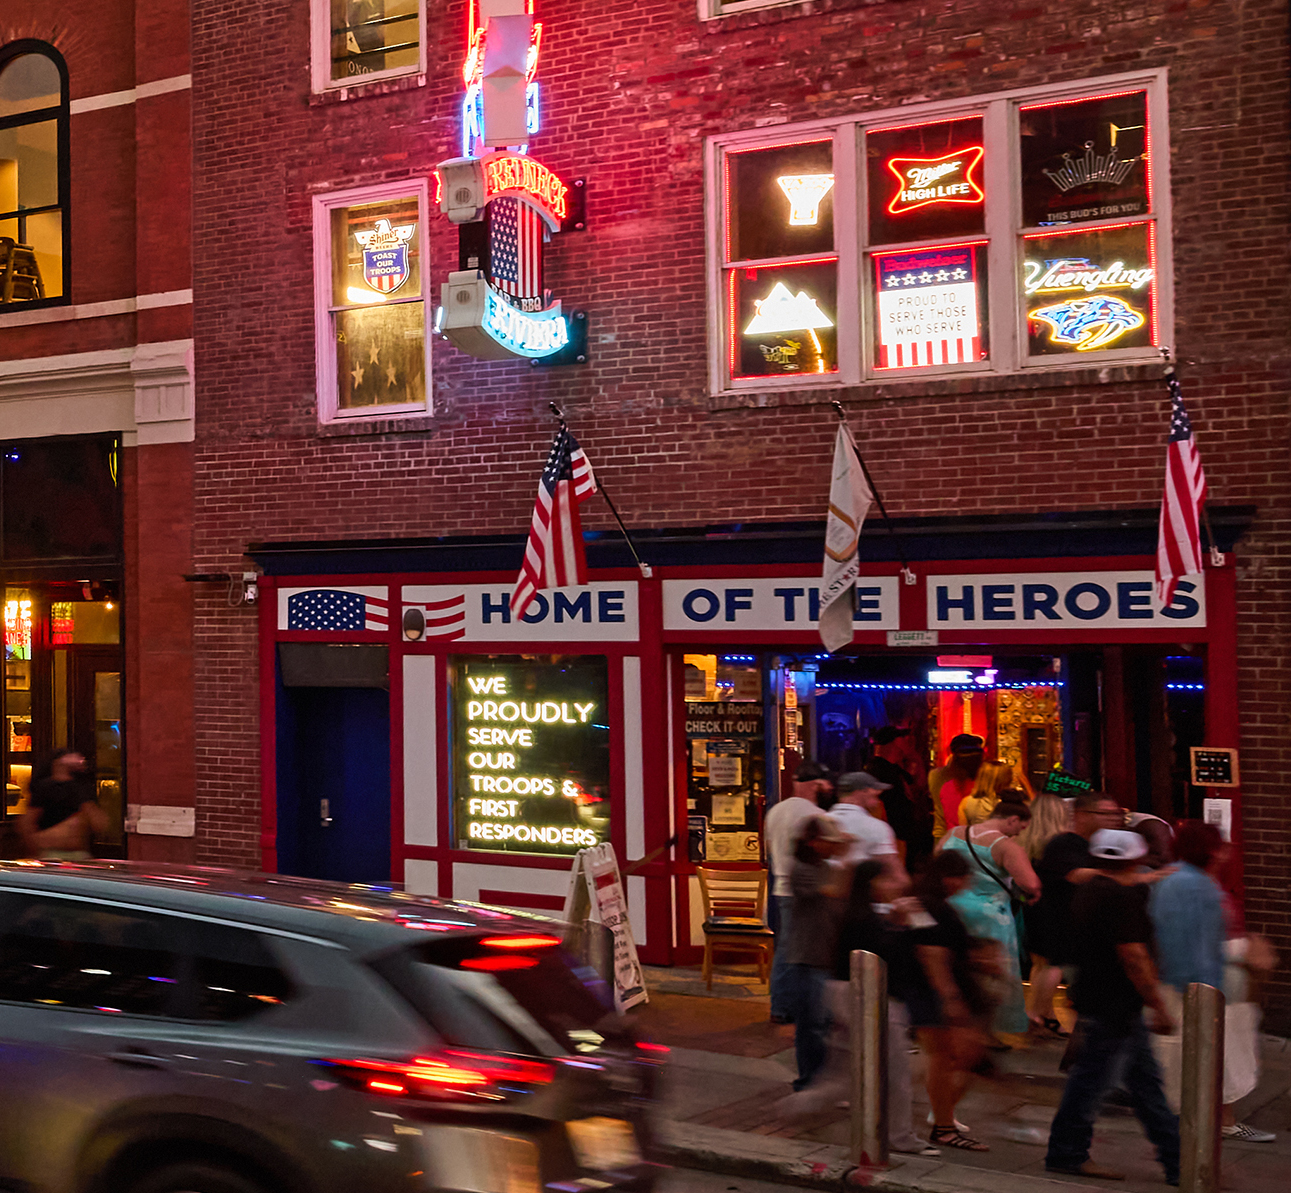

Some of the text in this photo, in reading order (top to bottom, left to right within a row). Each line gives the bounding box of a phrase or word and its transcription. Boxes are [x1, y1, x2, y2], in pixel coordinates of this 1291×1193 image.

[906, 161, 962, 188] Miller
[901, 183, 970, 202] HIGH LIFE
[1047, 203, 1140, 222] THIS BUD'S FOR YOU
[369, 228, 399, 246] Shiner
[372, 252, 397, 262] TOAST
[377, 259, 394, 268] OUR
[370, 266, 401, 276] TROOPS
[1023, 261, 1155, 294] Yuengling
[491, 283, 512, 303] BAR
[521, 297, 542, 312] BBQ
[898, 292, 956, 306] PROUD TO
[889, 305, 967, 323] SERVE THOSE
[896, 320, 962, 335] WHO SERVE
[481, 590, 626, 624] HOME
[681, 587, 754, 623] OF
[936, 580, 1200, 622] HEROES
[467, 676, 507, 695] WE
[467, 701, 595, 724] PROUDLY
[689, 703, 715, 715] Floor
[717, 703, 725, 715] &
[685, 720, 758, 733] CHECK IT OUT
[468, 727, 533, 748] SERVE
[468, 751, 516, 770] OUR
[469, 775, 580, 798] TROOPS &
[469, 799, 519, 818] FIRST
[469, 822, 597, 847] RESPONDERS
